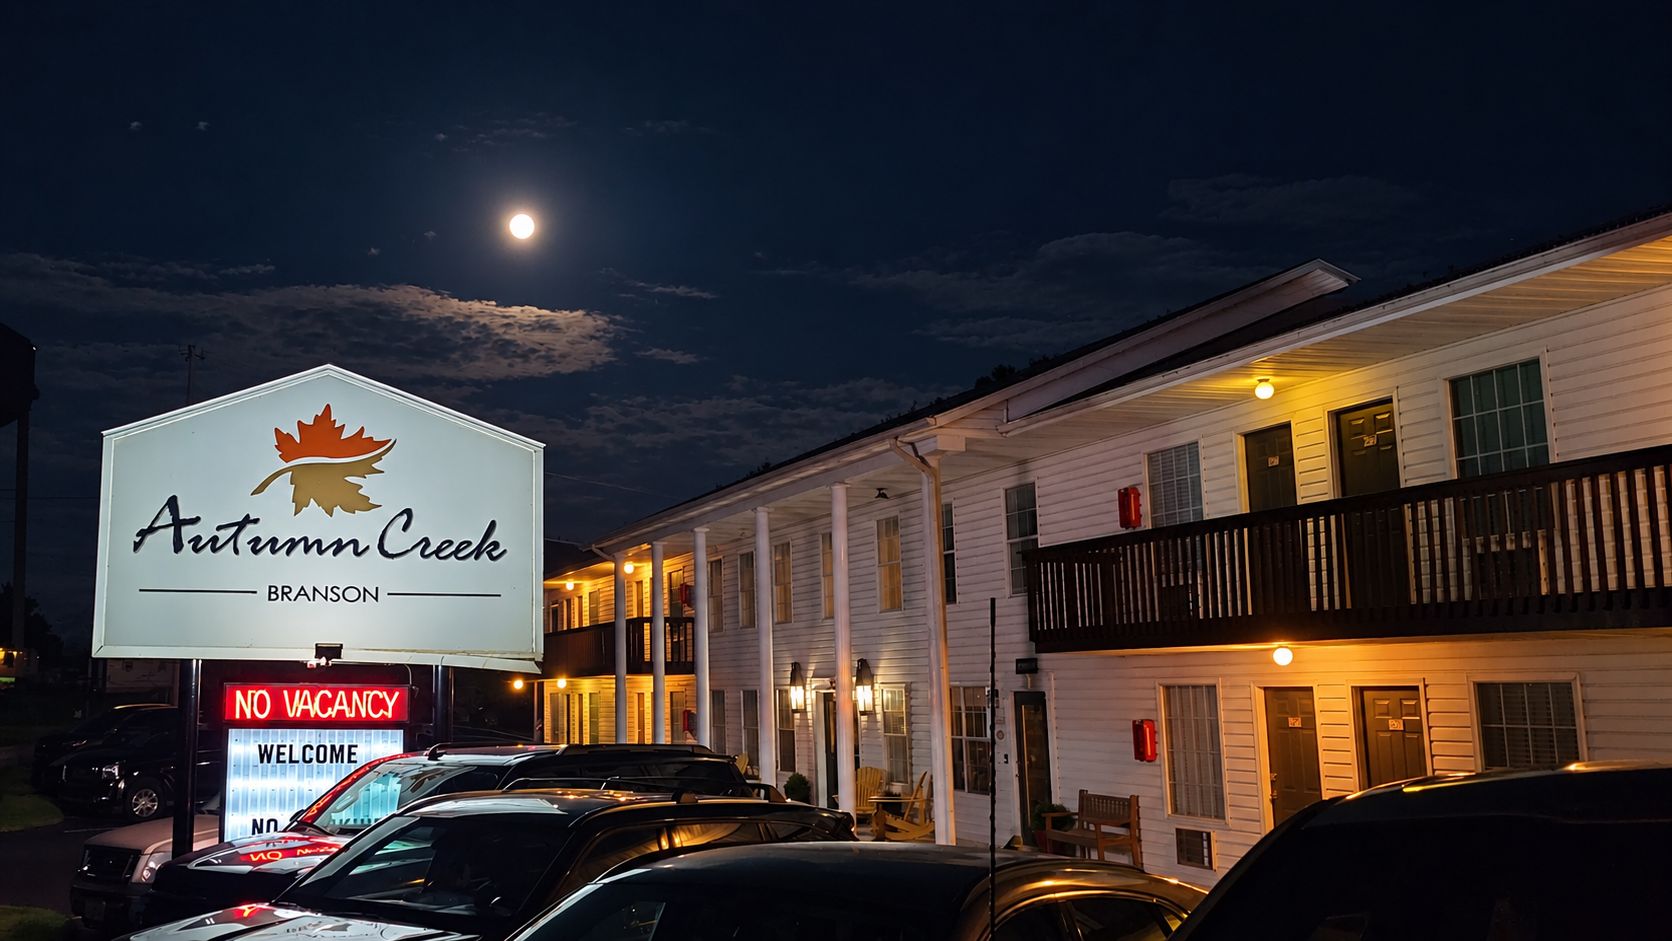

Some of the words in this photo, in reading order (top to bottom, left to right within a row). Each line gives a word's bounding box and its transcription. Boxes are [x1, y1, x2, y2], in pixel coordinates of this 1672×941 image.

[133, 494, 370, 556] Autumn
[377, 507, 507, 562] Creek
[267, 585, 379, 603] BRANSON
[235, 689, 271, 719] NO
[283, 689, 400, 719] VACANCY
[258, 744, 358, 764] WELCOME
